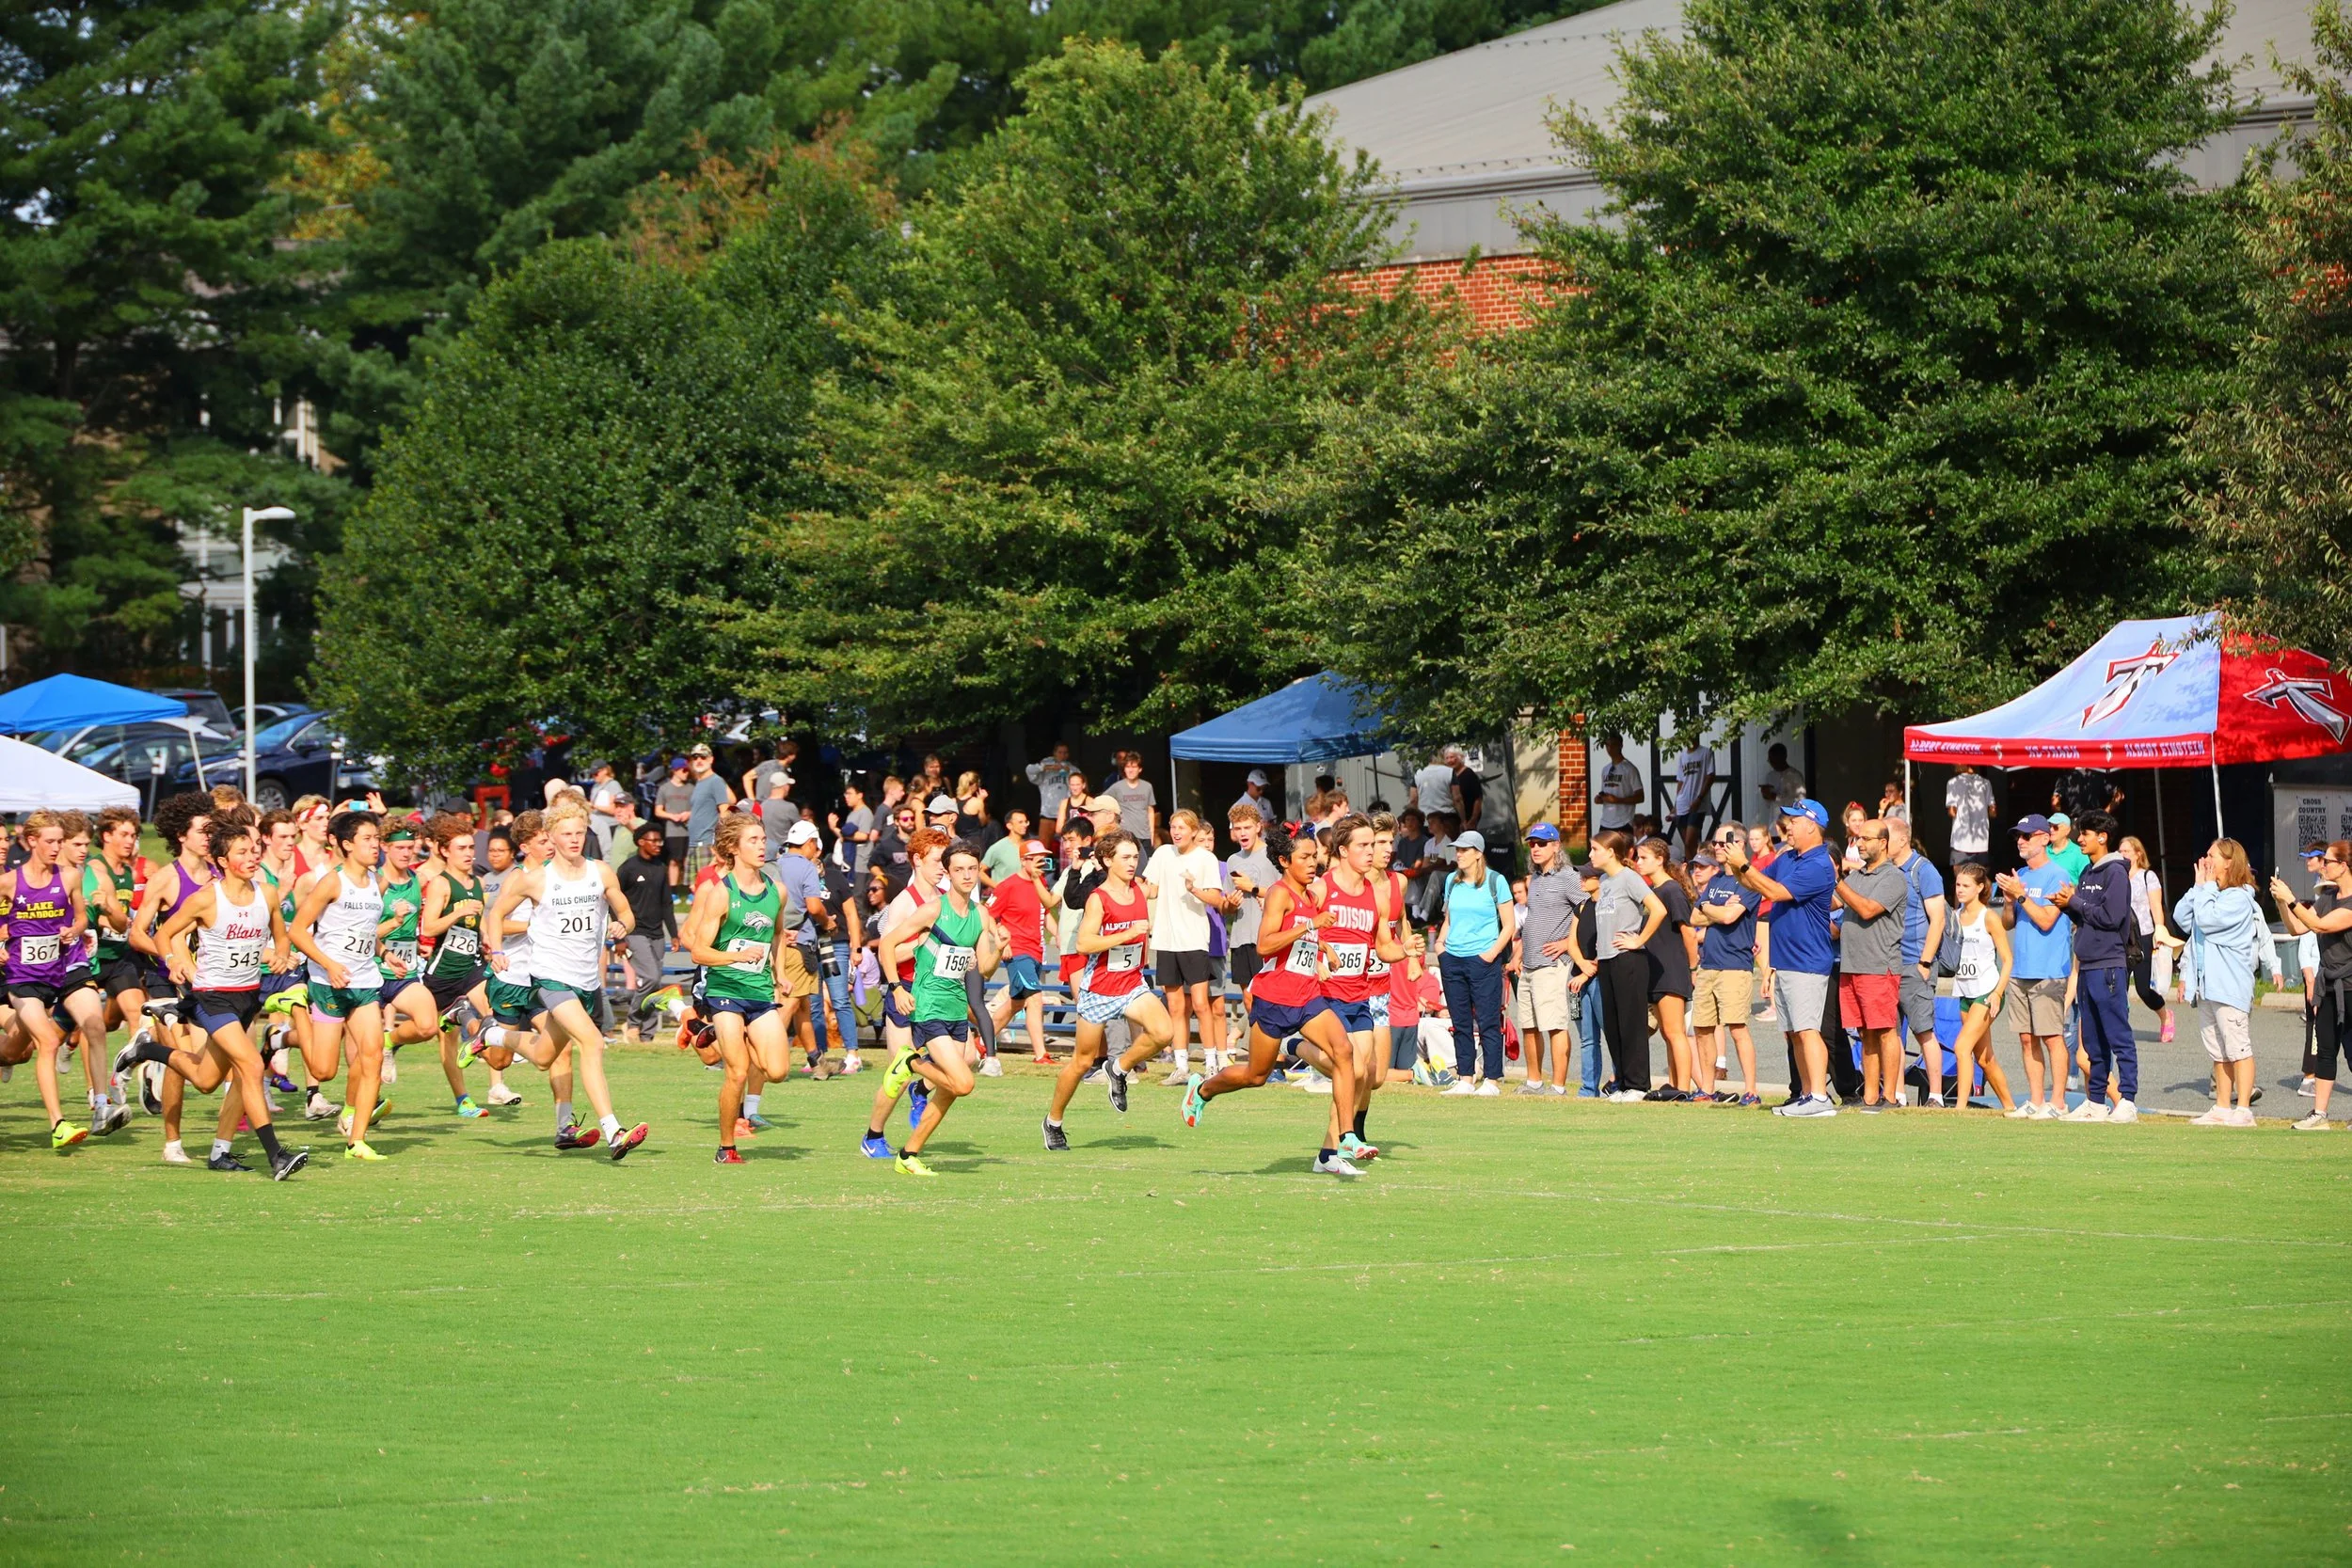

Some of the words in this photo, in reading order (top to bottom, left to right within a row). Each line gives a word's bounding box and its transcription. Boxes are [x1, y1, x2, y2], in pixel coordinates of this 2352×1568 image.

[2124, 742, 2159, 757] ALBERT
[2159, 740, 2205, 757] EINSTEIN
[26, 901, 54, 911] LAKE
[344, 901, 363, 911] FALLS
[551, 896, 572, 906] FALLS
[574, 895, 600, 904] CHURCH
[16, 908, 65, 919] BRADDOCK
[1328, 905, 1374, 932] EDISON
[226, 924, 262, 940] Blair
[560, 916, 594, 934] 201
[1104, 921, 1131, 931] ALBERT
[26, 944, 57, 961] 367
[344, 936, 373, 956] 218
[449, 935, 475, 953] 126
[230, 951, 261, 968] 543
[1123, 954, 1133, 968] 5
[1339, 952, 1362, 969] 365
